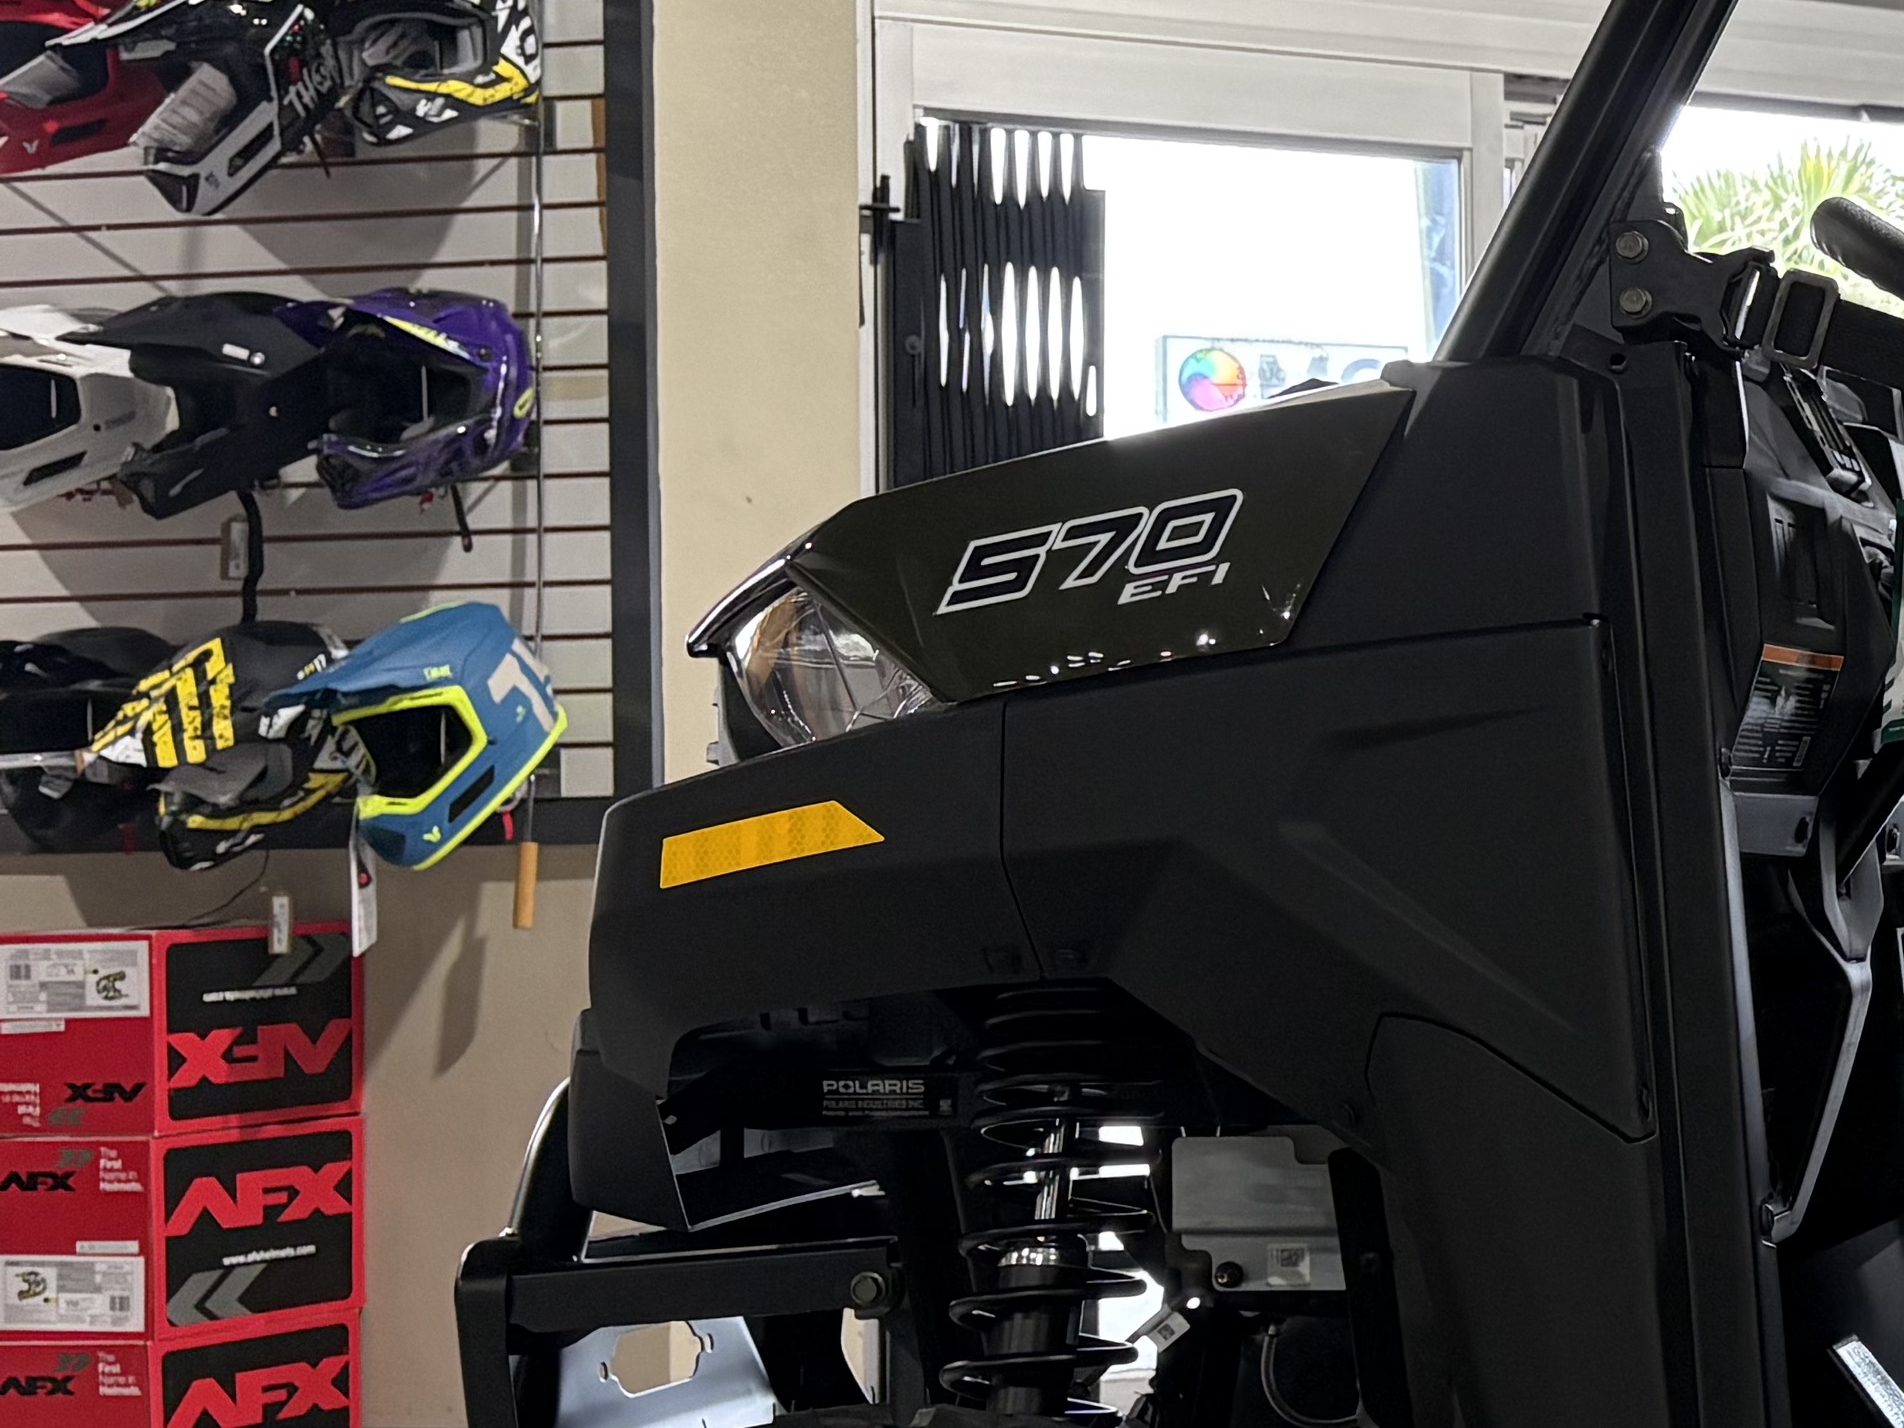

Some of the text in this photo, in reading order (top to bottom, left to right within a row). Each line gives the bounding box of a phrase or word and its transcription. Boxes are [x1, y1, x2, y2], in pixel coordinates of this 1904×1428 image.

[936, 488, 1243, 615] 570
[1117, 562, 1230, 605] EFI
[168, 1019, 350, 1089] AFX
[64, 1082, 146, 1103] AFX
[823, 1080, 925, 1093] POLARIS
[0, 1171, 76, 1192] AFX
[166, 1162, 352, 1237] AFX
[0, 1376, 75, 1396] AFX
